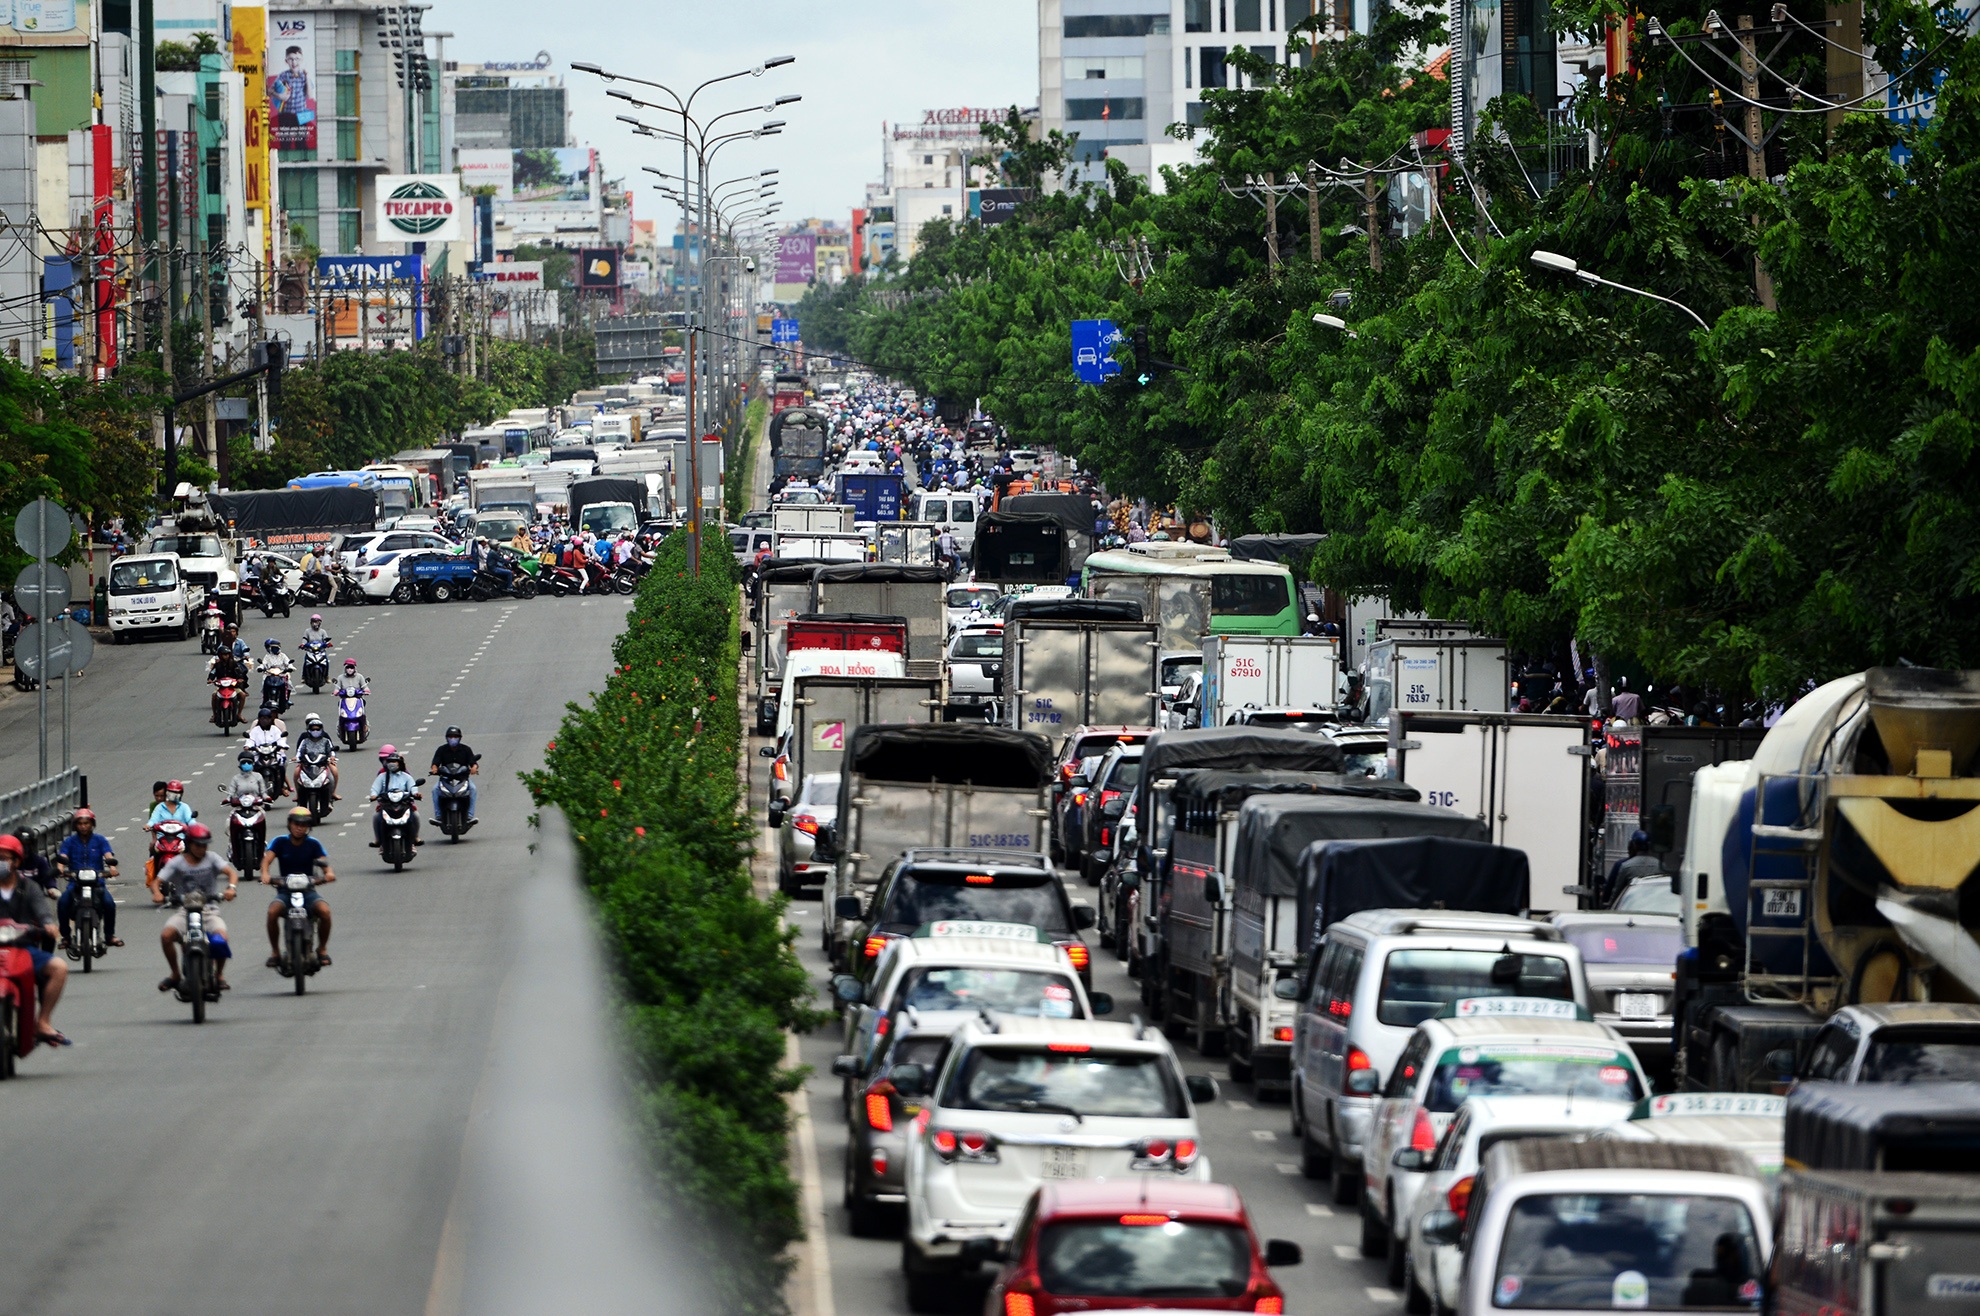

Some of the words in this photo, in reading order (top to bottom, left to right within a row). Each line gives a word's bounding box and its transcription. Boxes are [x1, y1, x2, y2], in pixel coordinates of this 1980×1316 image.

[277, 20, 306, 32] VUS
[384, 202, 453, 216] TECAPRO
[267, 534, 305, 545] NGUYEN
[306, 532, 331, 542] NGOC
[1235, 658, 1255, 667] 51C
[820, 665, 841, 675] HOA
[1231, 668, 1261, 677] 87910
[1411, 684, 1425, 693] 51C
[1036, 698, 1052, 709] 51C
[1406, 694, 1430, 703] 763.97
[1028, 712, 1062, 723] 347.02
